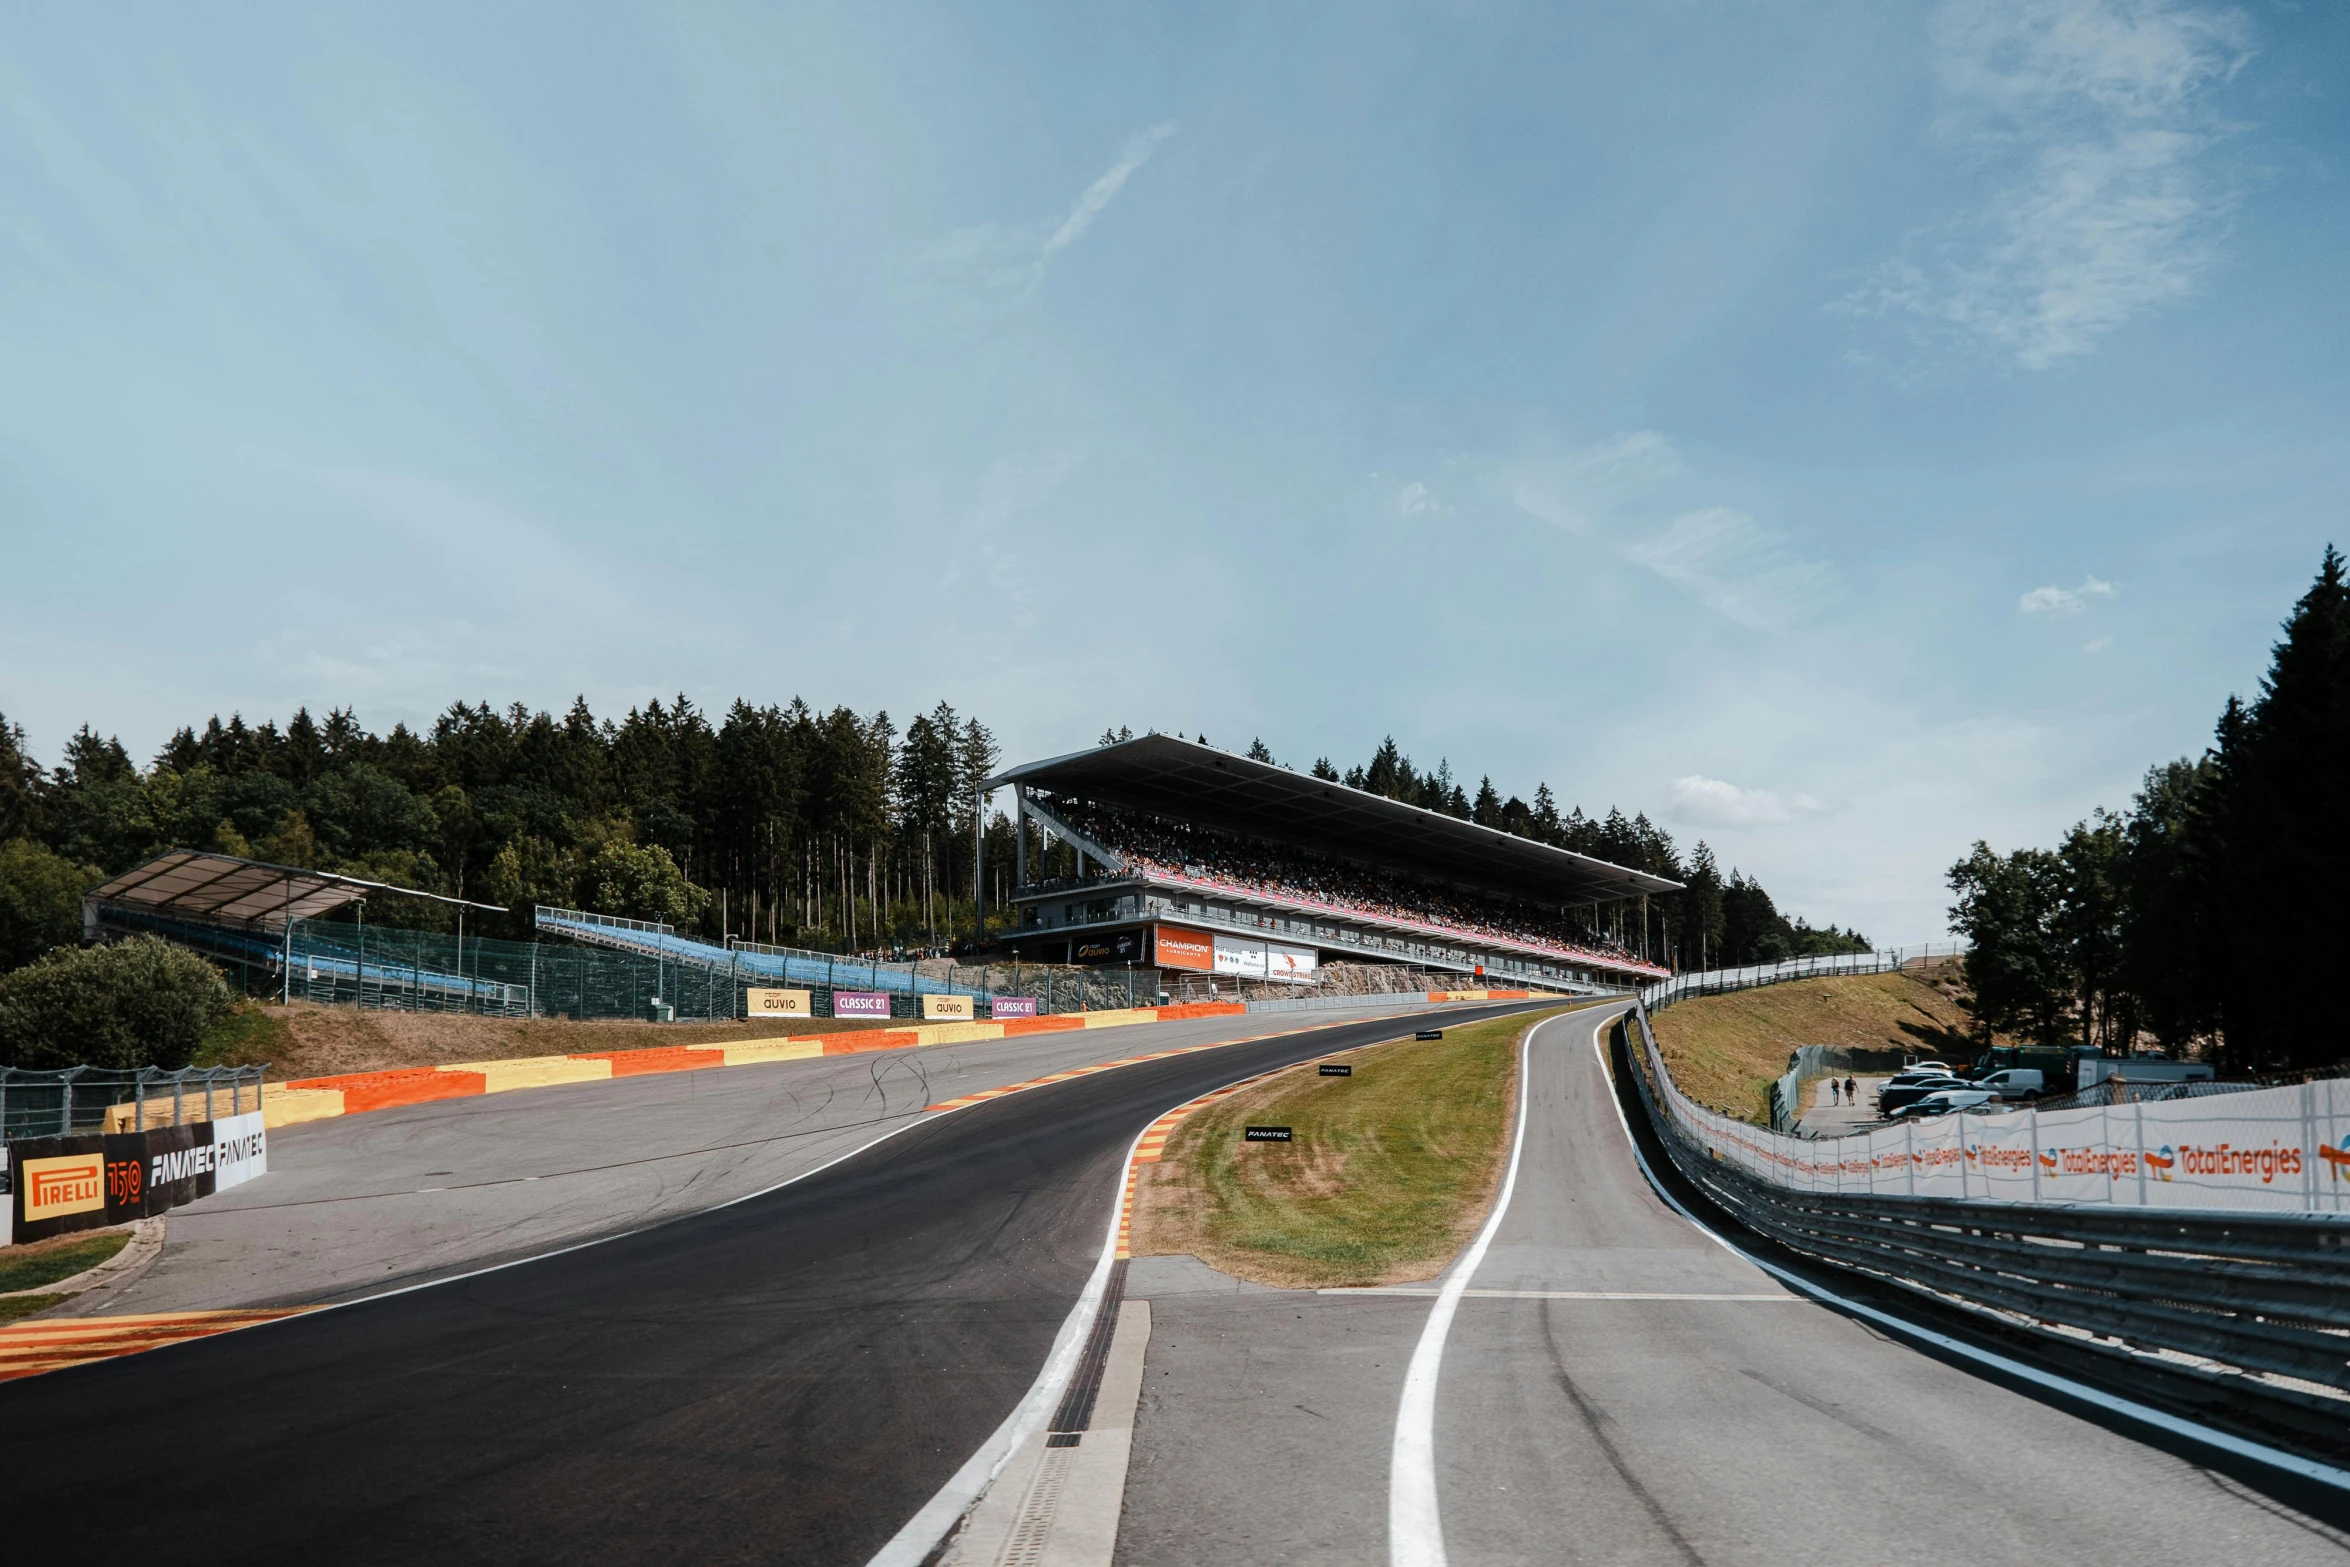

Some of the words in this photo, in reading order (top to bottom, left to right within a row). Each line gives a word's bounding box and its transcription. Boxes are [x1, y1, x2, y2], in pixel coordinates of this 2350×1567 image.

[1088, 947, 1110, 957] auvio
[1159, 938, 1209, 953] CHAMPION
[1166, 948, 1201, 957] LUBRICANTS
[763, 999, 796, 1010] auvio
[839, 997, 874, 1009] CLASSIC
[875, 998, 885, 1010] 21
[936, 1003, 962, 1013] auvio
[996, 1002, 1023, 1012] CLASSIC
[1025, 1003, 1033, 1012] 21
[219, 1132, 262, 1167] FANATEC
[1977, 1145, 2032, 1173] TotalEnergies
[151, 1144, 214, 1187] FANATEC
[2060, 1145, 2137, 1181] TotalEnergies
[2179, 1139, 2302, 1183] TotalEnergies
[31, 1165, 98, 1207] PIRELLI
[107, 1160, 142, 1206] 150
